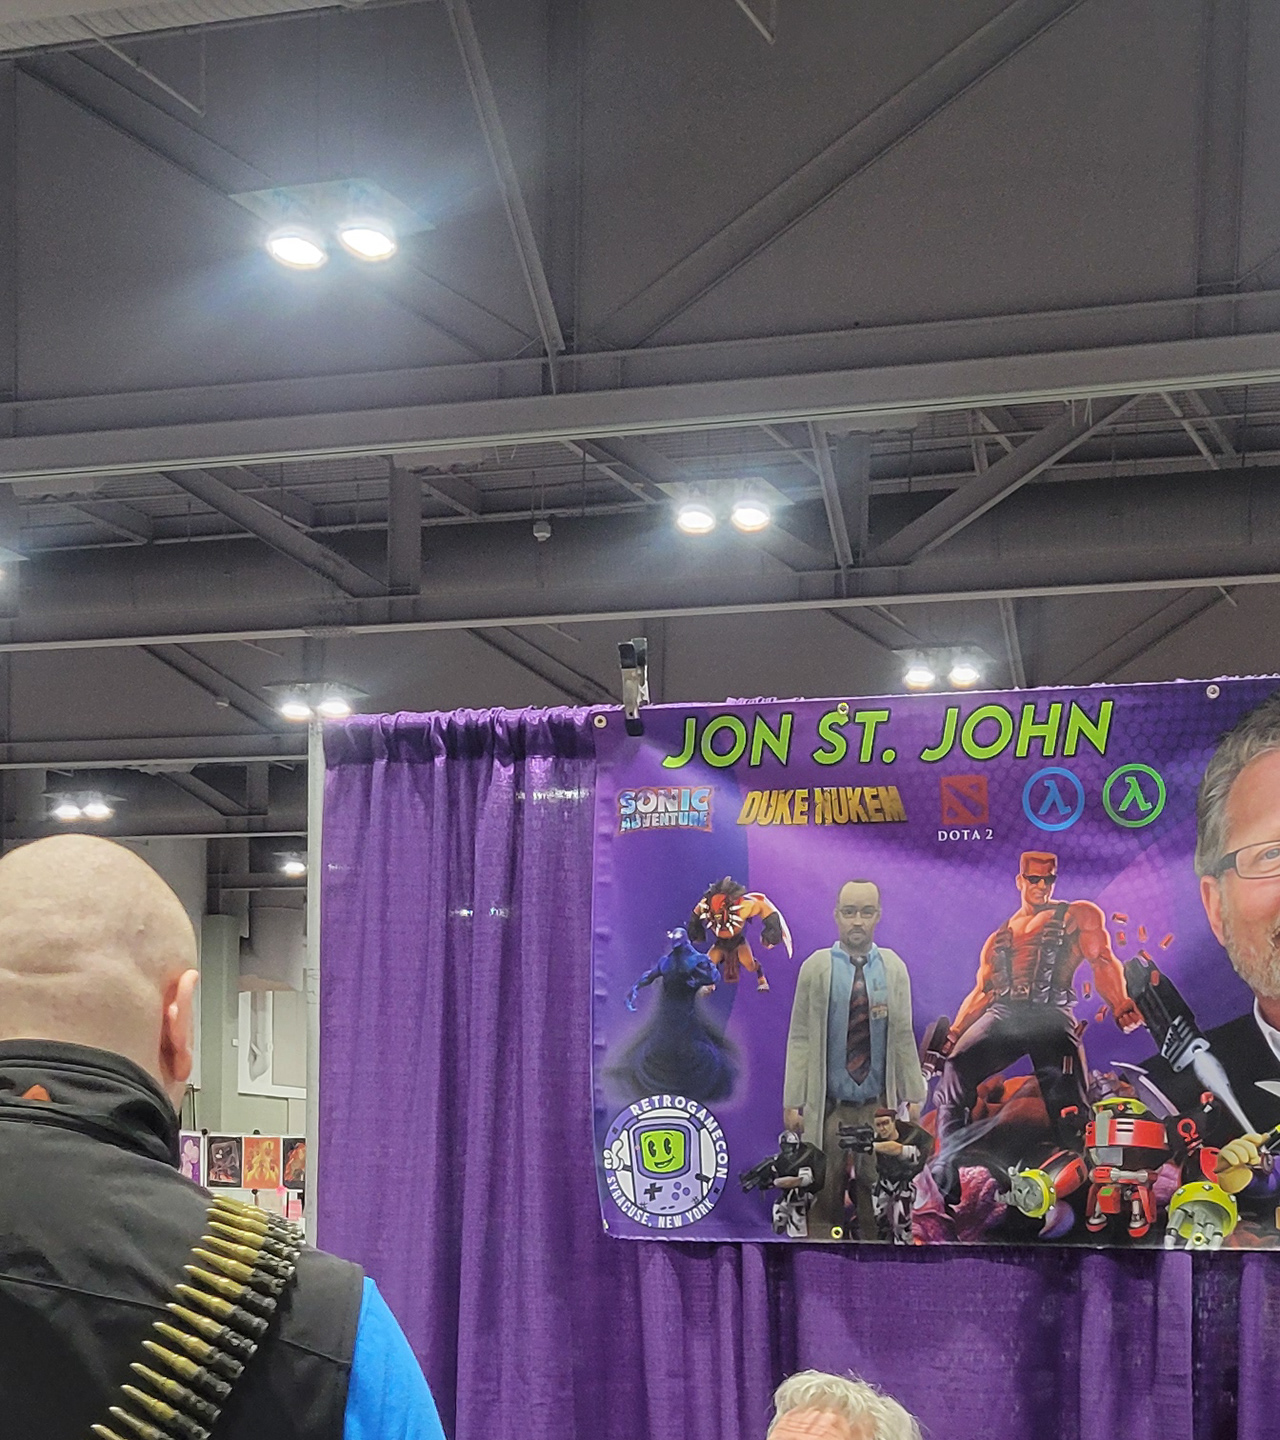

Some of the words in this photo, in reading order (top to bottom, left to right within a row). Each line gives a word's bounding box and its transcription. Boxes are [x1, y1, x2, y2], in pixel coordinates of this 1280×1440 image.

[662, 713, 793, 769] JON
[812, 709, 897, 766] ST.
[920, 700, 1115, 763] JOHN
[619, 787, 711, 815] SONIC
[620, 811, 709, 832] ADVENTURE
[736, 788, 810, 827] DUKE
[813, 785, 909, 827] NUKEM
[937, 830, 982, 842] DOTA
[984, 828, 995, 841] 2
[629, 1094, 729, 1179] RETROGAMECON
[606, 1176, 653, 1228] SYRACUSE,
[658, 1214, 683, 1229] NEW
[685, 1198, 715, 1223] YORK
